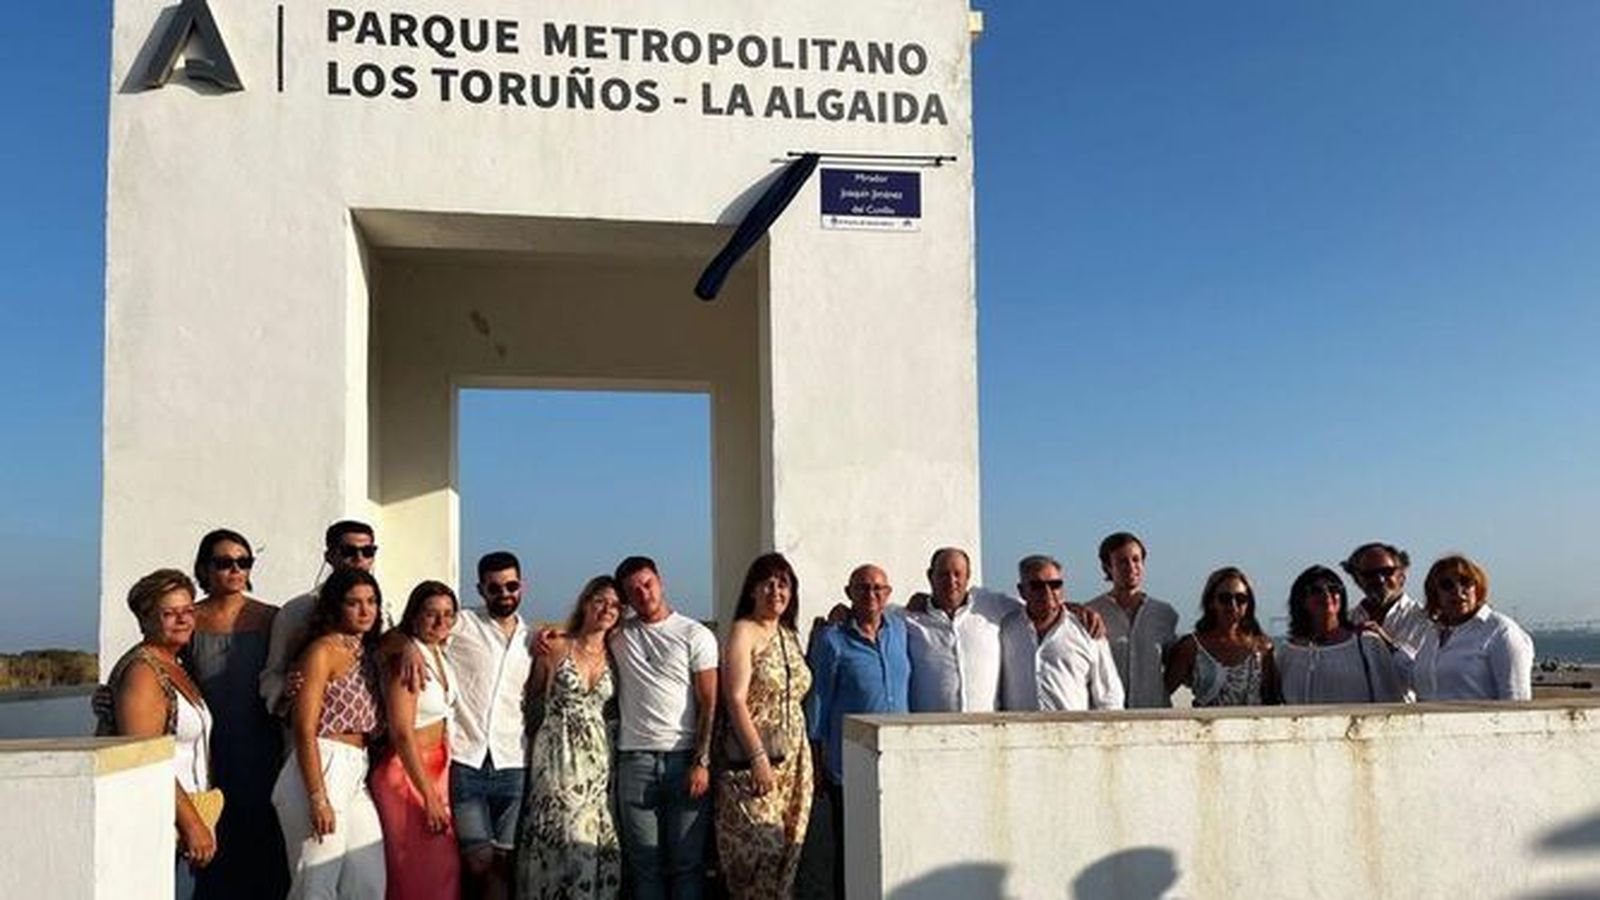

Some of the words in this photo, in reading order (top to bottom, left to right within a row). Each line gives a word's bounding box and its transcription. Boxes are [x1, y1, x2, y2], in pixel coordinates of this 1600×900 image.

[327, 8, 519, 59] PARQUE
[543, 22, 927, 76] METROPOLITANO
[327, 61, 418, 101] LOS
[431, 66, 660, 113] TORUÑOS
[702, 82, 754, 117] LA
[764, 86, 948, 125] ALGAIDA
